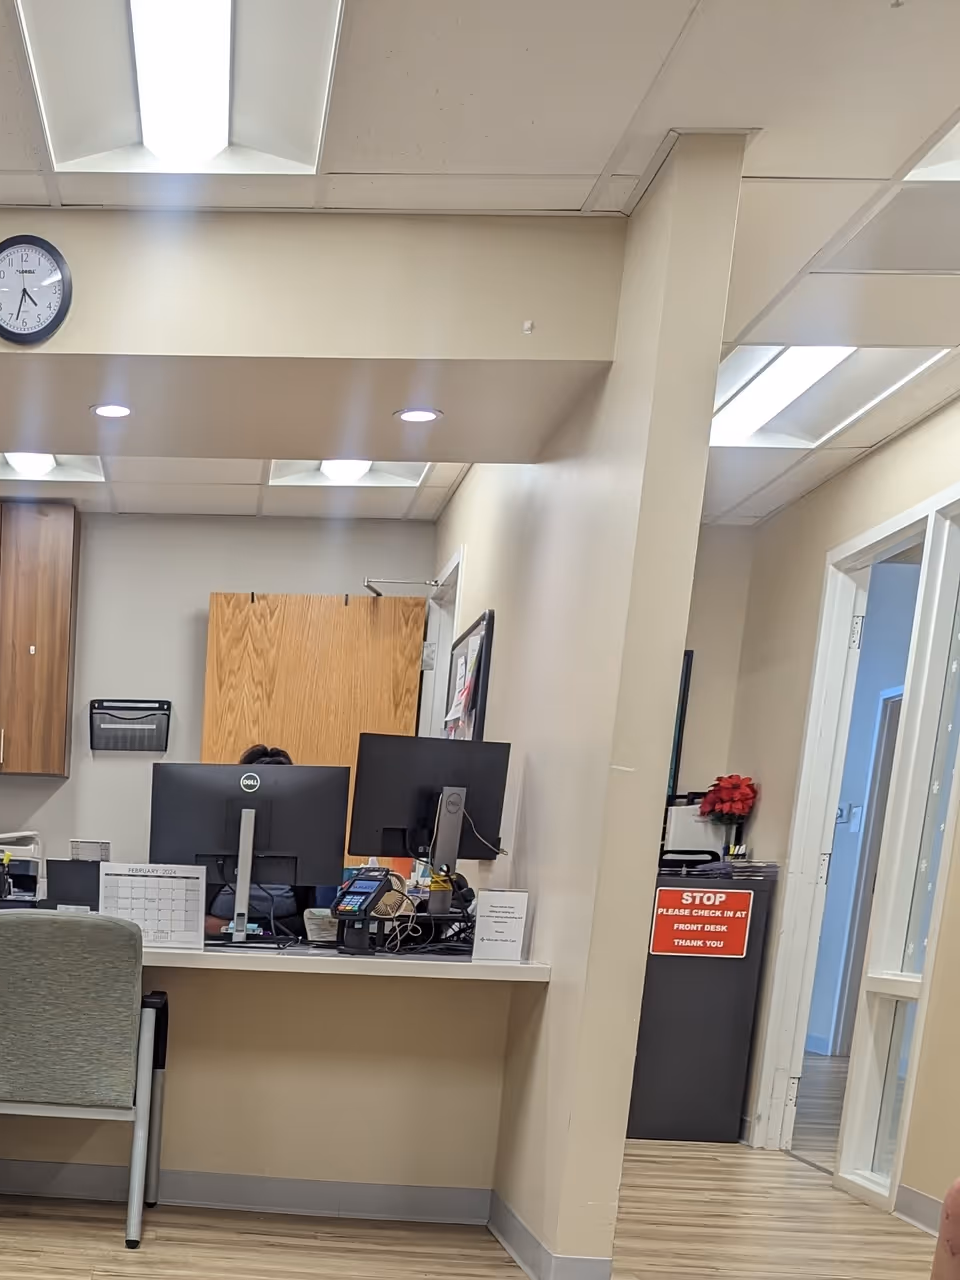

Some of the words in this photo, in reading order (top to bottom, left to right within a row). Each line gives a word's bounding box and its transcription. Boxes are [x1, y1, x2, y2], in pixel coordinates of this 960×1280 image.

[21, 253, 29, 262] 12
[8, 258, 13, 267] 11
[52, 286, 57, 294] 3
[46, 302, 52, 311] 4
[8, 313, 13, 322] 7
[36, 313, 41, 323] 5
[22, 318, 27, 327] 6
[681, 892, 726, 905] STOP
[658, 908, 690, 916] PLEASE
[692, 909, 722, 917] CHECK
[674, 923, 703, 931] FRONT
[674, 939, 704, 947] THANK
